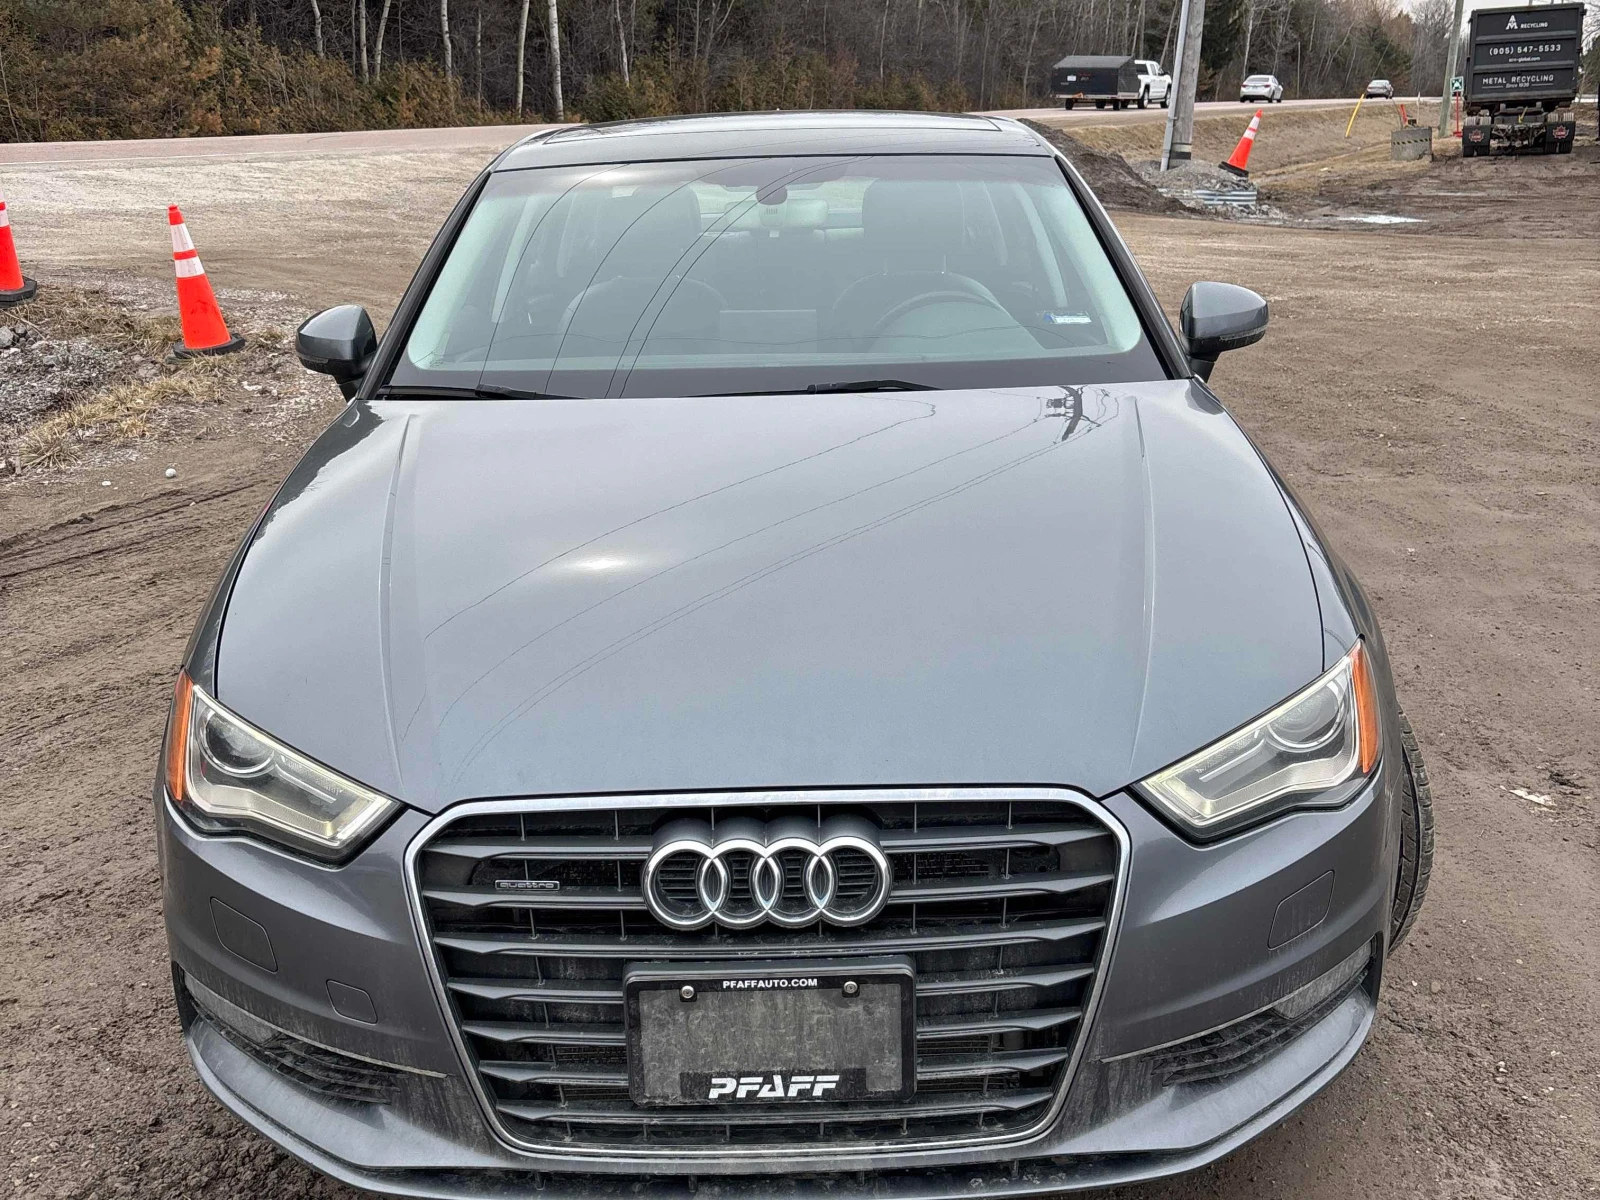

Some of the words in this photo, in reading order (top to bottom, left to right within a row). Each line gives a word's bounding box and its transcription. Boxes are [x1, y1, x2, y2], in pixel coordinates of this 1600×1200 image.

[1489, 47, 1514, 56] (905)
[1517, 44, 1561, 54] 547-5533
[1511, 74, 1554, 83] RECYCLING
[722, 978, 818, 989] PFAFFAUTO.COM
[708, 1074, 840, 1099] PFAFF
